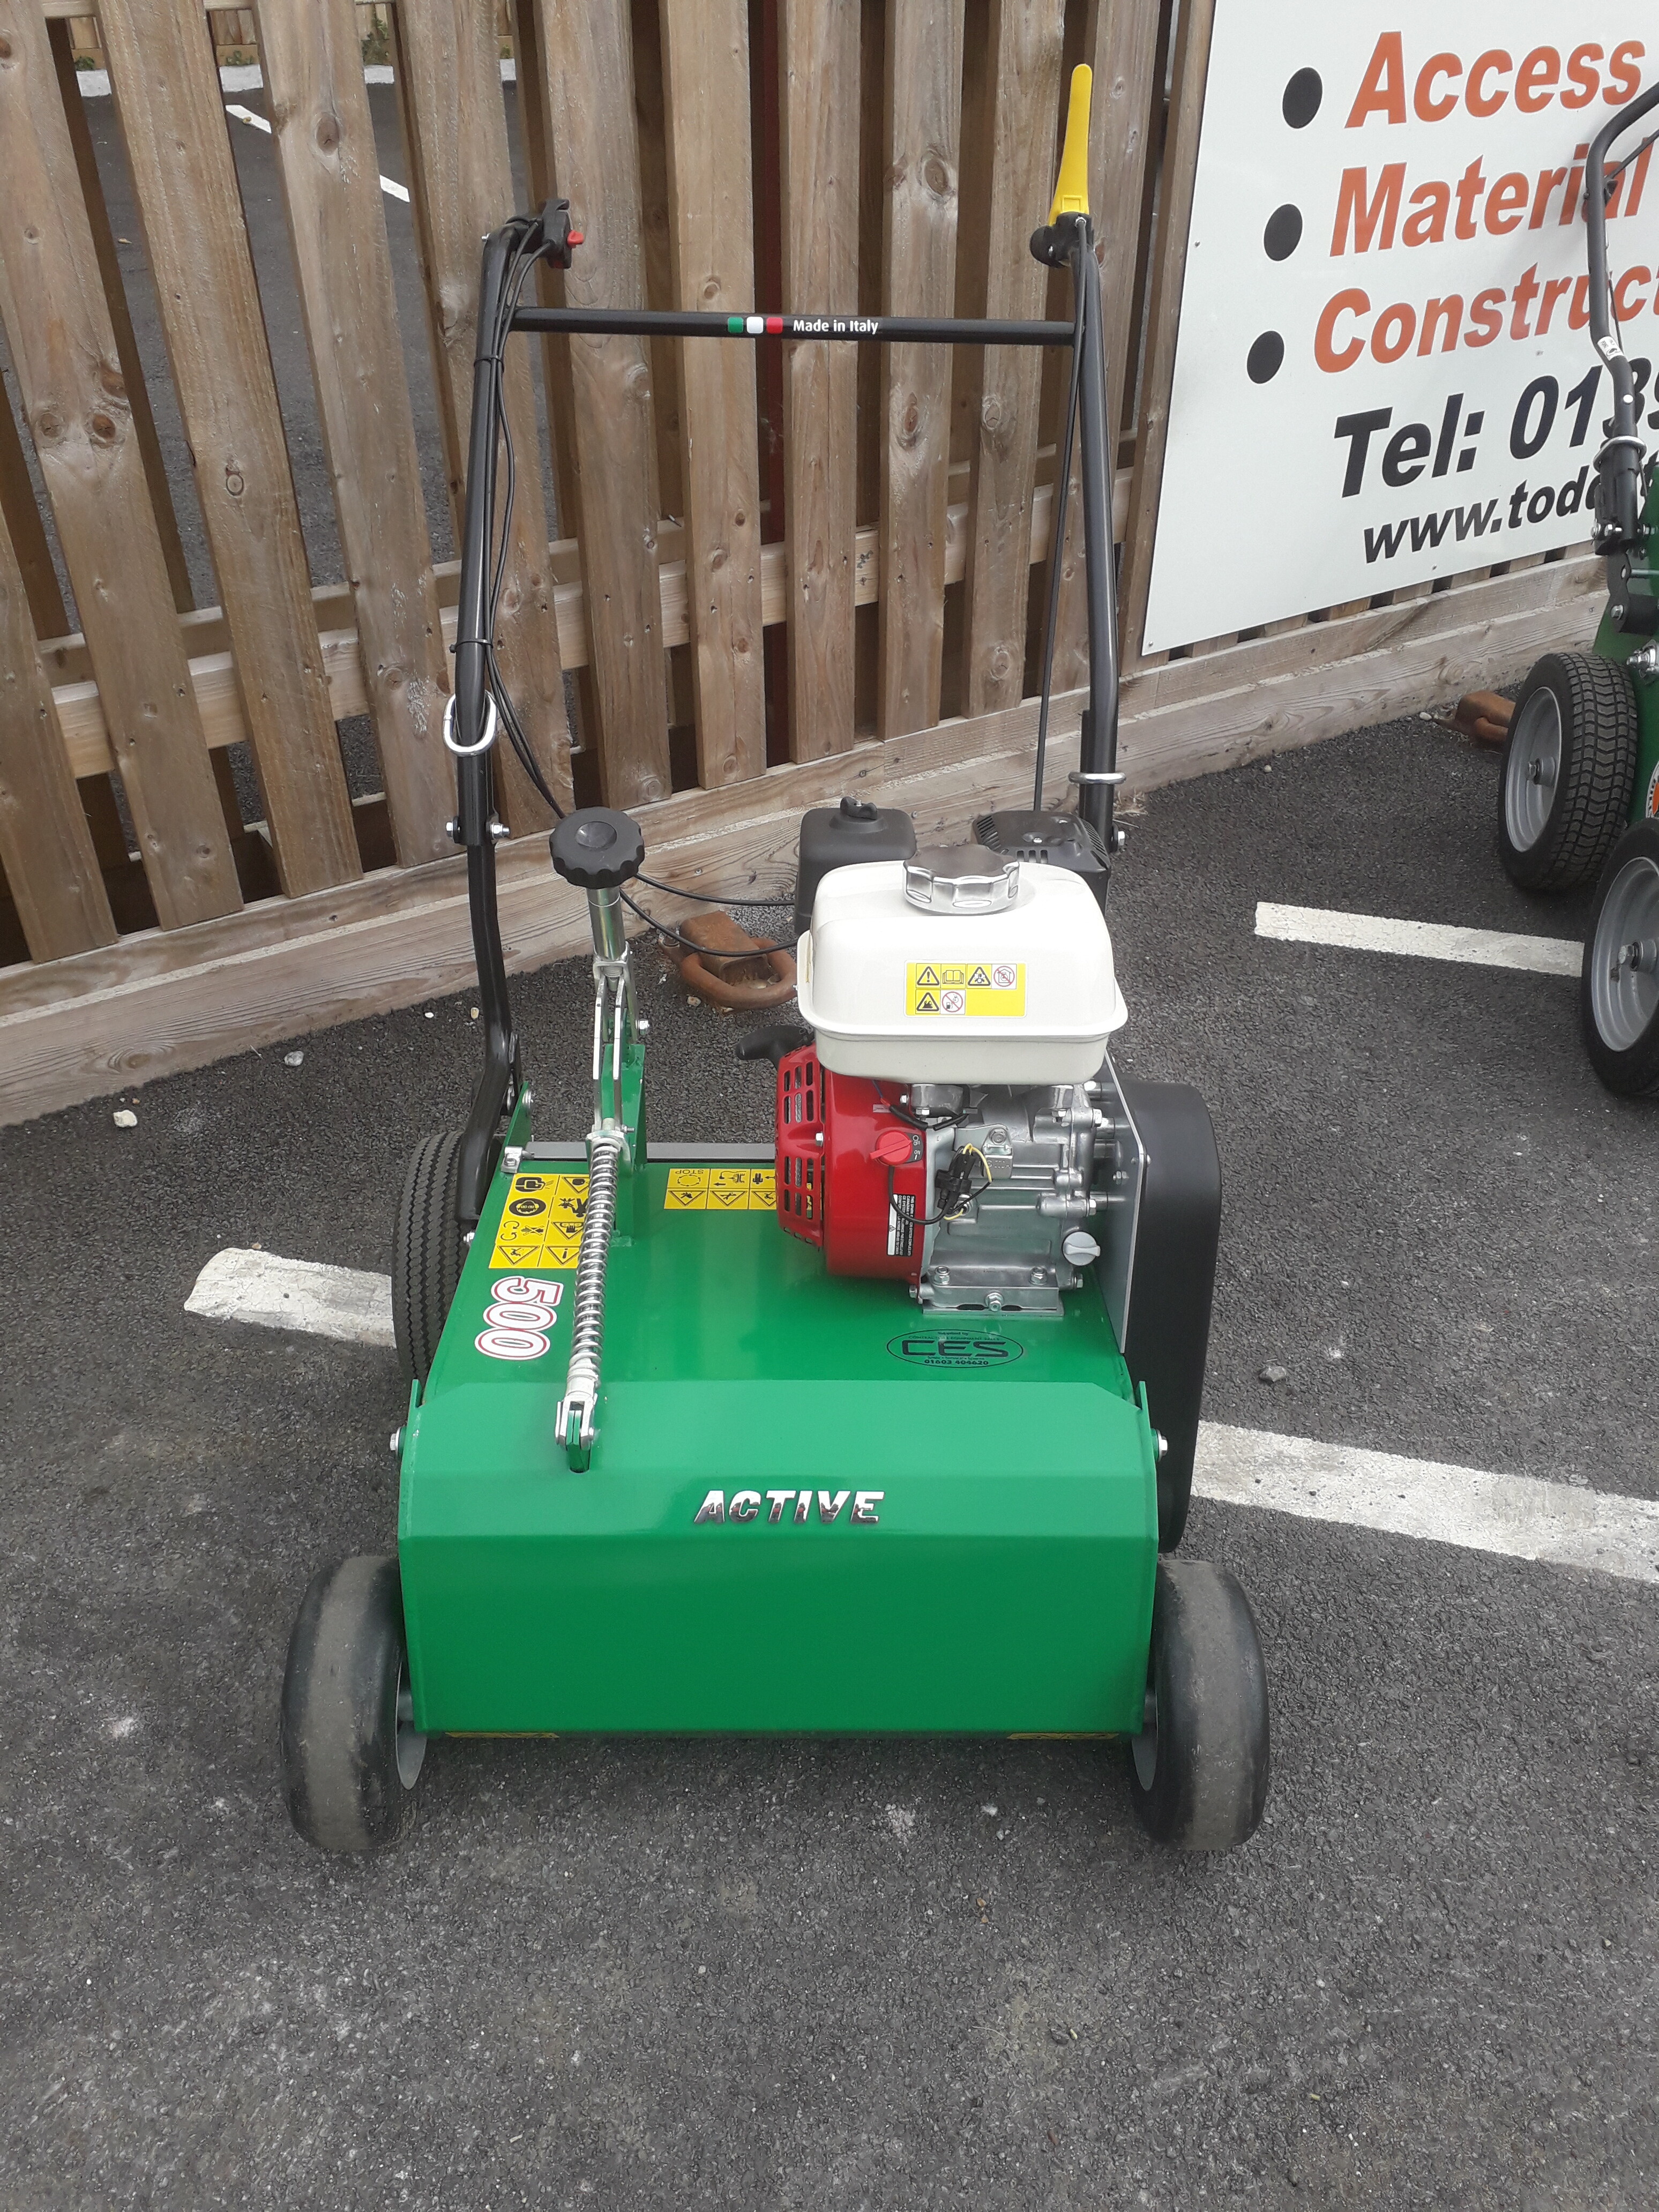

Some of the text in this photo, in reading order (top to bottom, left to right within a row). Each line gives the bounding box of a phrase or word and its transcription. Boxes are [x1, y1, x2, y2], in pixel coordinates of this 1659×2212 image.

[1344, 31, 1646, 128] Access
[793, 319, 878, 335] Made in Italy
[1313, 262, 1659, 373] Construc
[1334, 393, 1485, 498] Tel:
[475, 1275, 564, 1361] 500
[902, 1340, 1008, 1357] CES
[694, 1490, 885, 1523] ACTIVE
